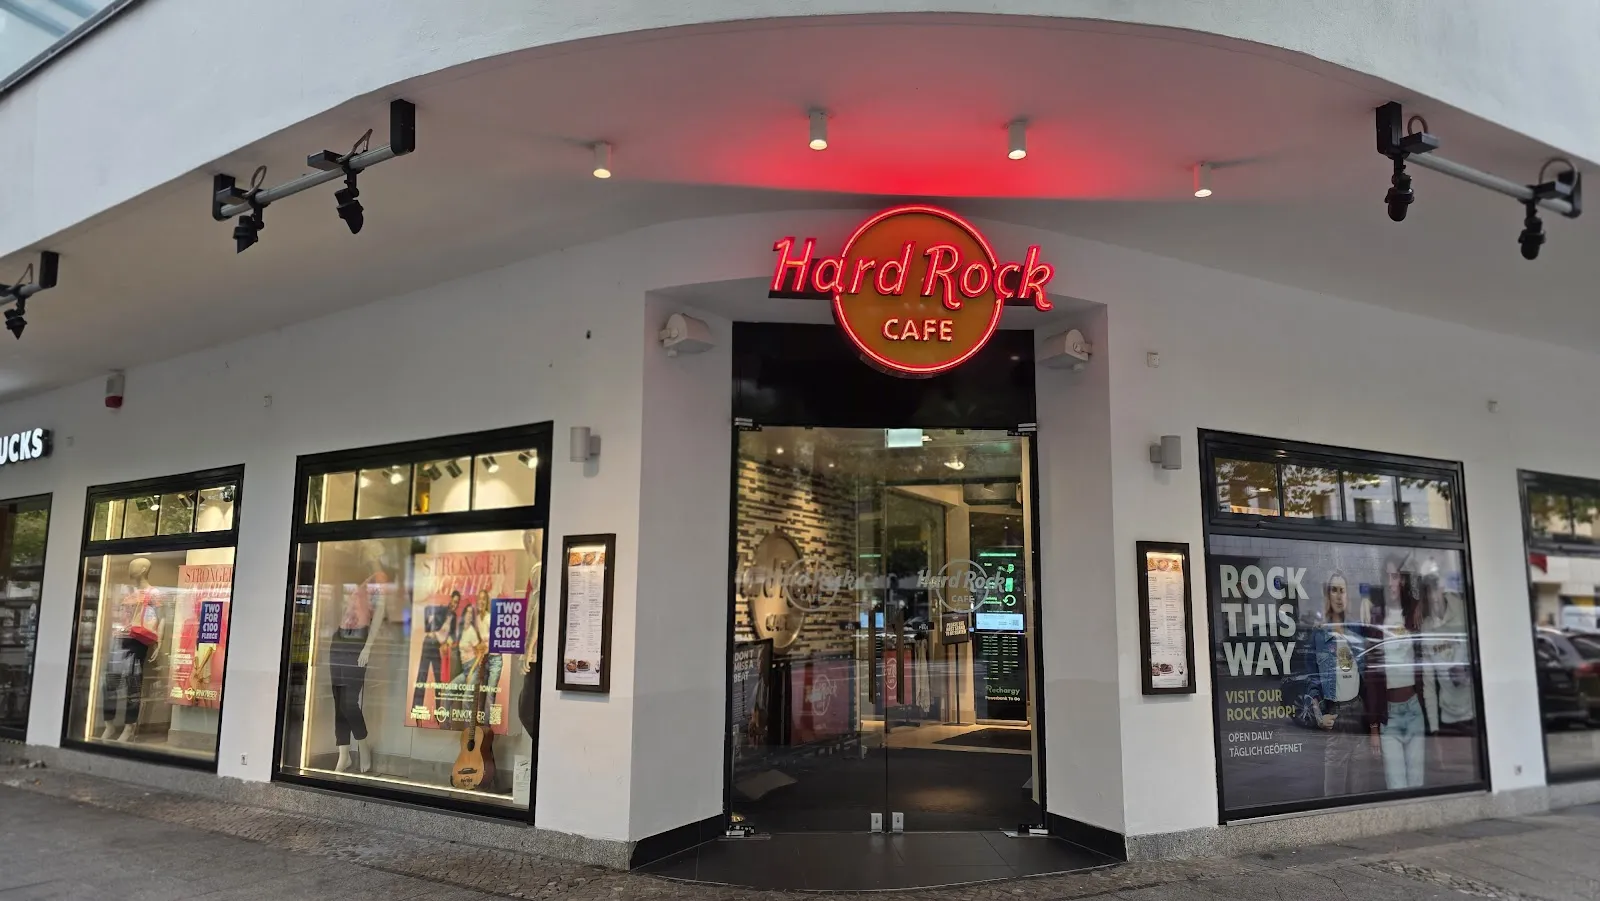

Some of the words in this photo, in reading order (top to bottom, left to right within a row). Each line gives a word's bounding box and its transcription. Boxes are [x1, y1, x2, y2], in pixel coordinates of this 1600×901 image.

[770, 236, 916, 295] Hard
[921, 244, 1055, 312] Rock
[882, 318, 954, 342] CAFE
[422, 554, 507, 577] STRONGER
[916, 569, 963, 588] Hard
[963, 570, 1006, 593] Rock
[1220, 564, 1309, 600] ROCK
[951, 595, 975, 603] CAFE
[204, 603, 221, 614] TWO
[495, 601, 522, 614] TWO
[203, 613, 219, 623] FOR
[497, 614, 520, 626] FOR
[1221, 603, 1297, 638] THIS
[494, 626, 520, 639] €100
[493, 639, 520, 649] FLEECE
[1222, 642, 1297, 677] WAY
[733, 671, 750, 684] BEAT
[985, 685, 1020, 696] Rechargy
[1225, 690, 1256, 704] VISIT
[1257, 689, 1283, 702] OUR
[1226, 706, 1260, 721] ROCK
[1261, 704, 1296, 720] SHOP!
[1228, 732, 1250, 743] OPEN
[1251, 731, 1274, 741] DAILY
[1229, 745, 1263, 757] TÄGLICH
[1263, 742, 1303, 755] GEÖFFNET
